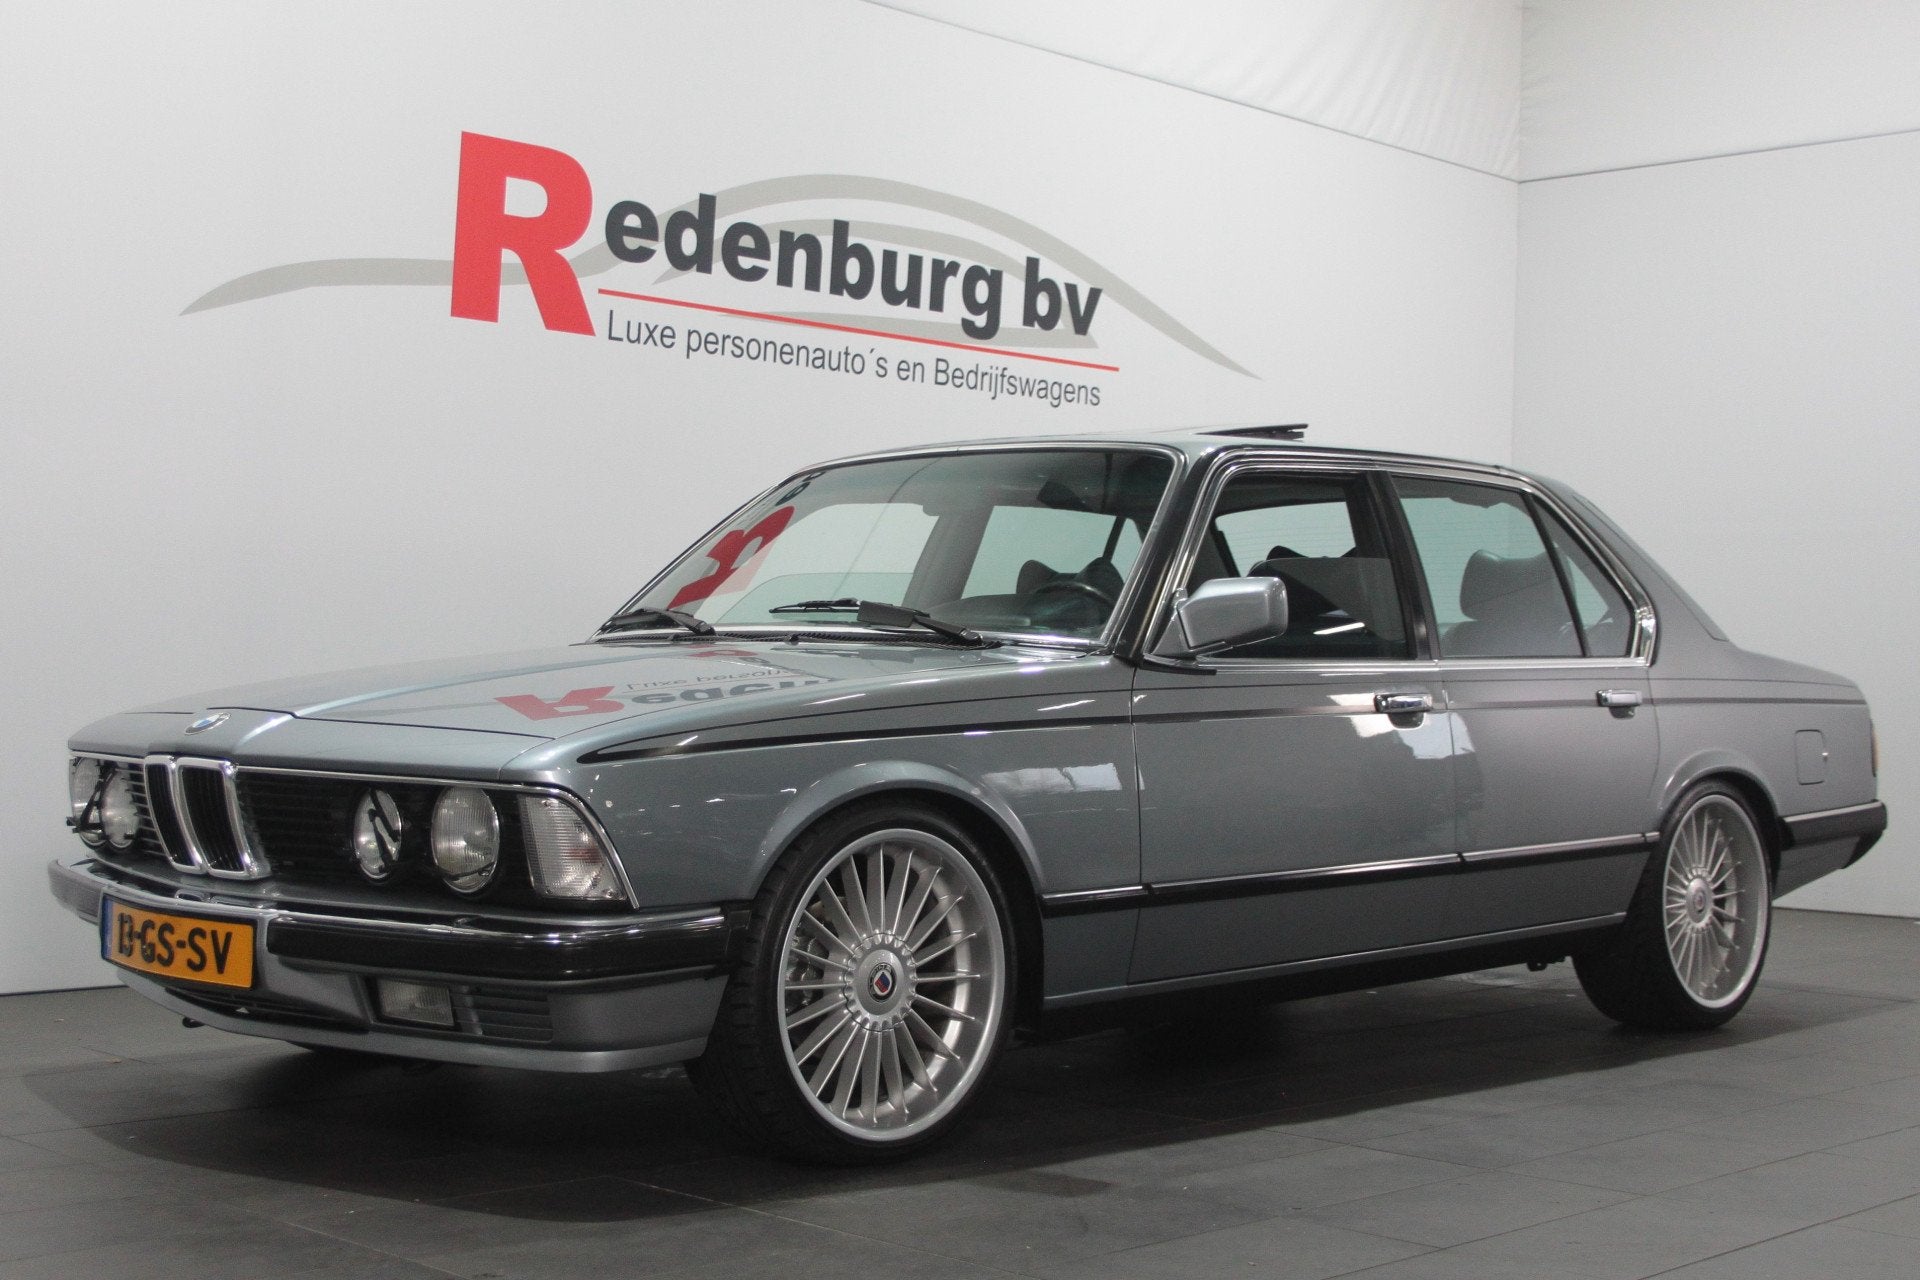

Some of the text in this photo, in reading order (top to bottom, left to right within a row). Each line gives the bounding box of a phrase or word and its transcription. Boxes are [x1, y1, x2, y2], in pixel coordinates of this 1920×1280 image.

[451, 130, 1103, 340] Redenburg bv
[607, 309, 677, 350] Luxe
[896, 359, 926, 383] en
[933, 357, 1102, 407] Bedrijfswagens
